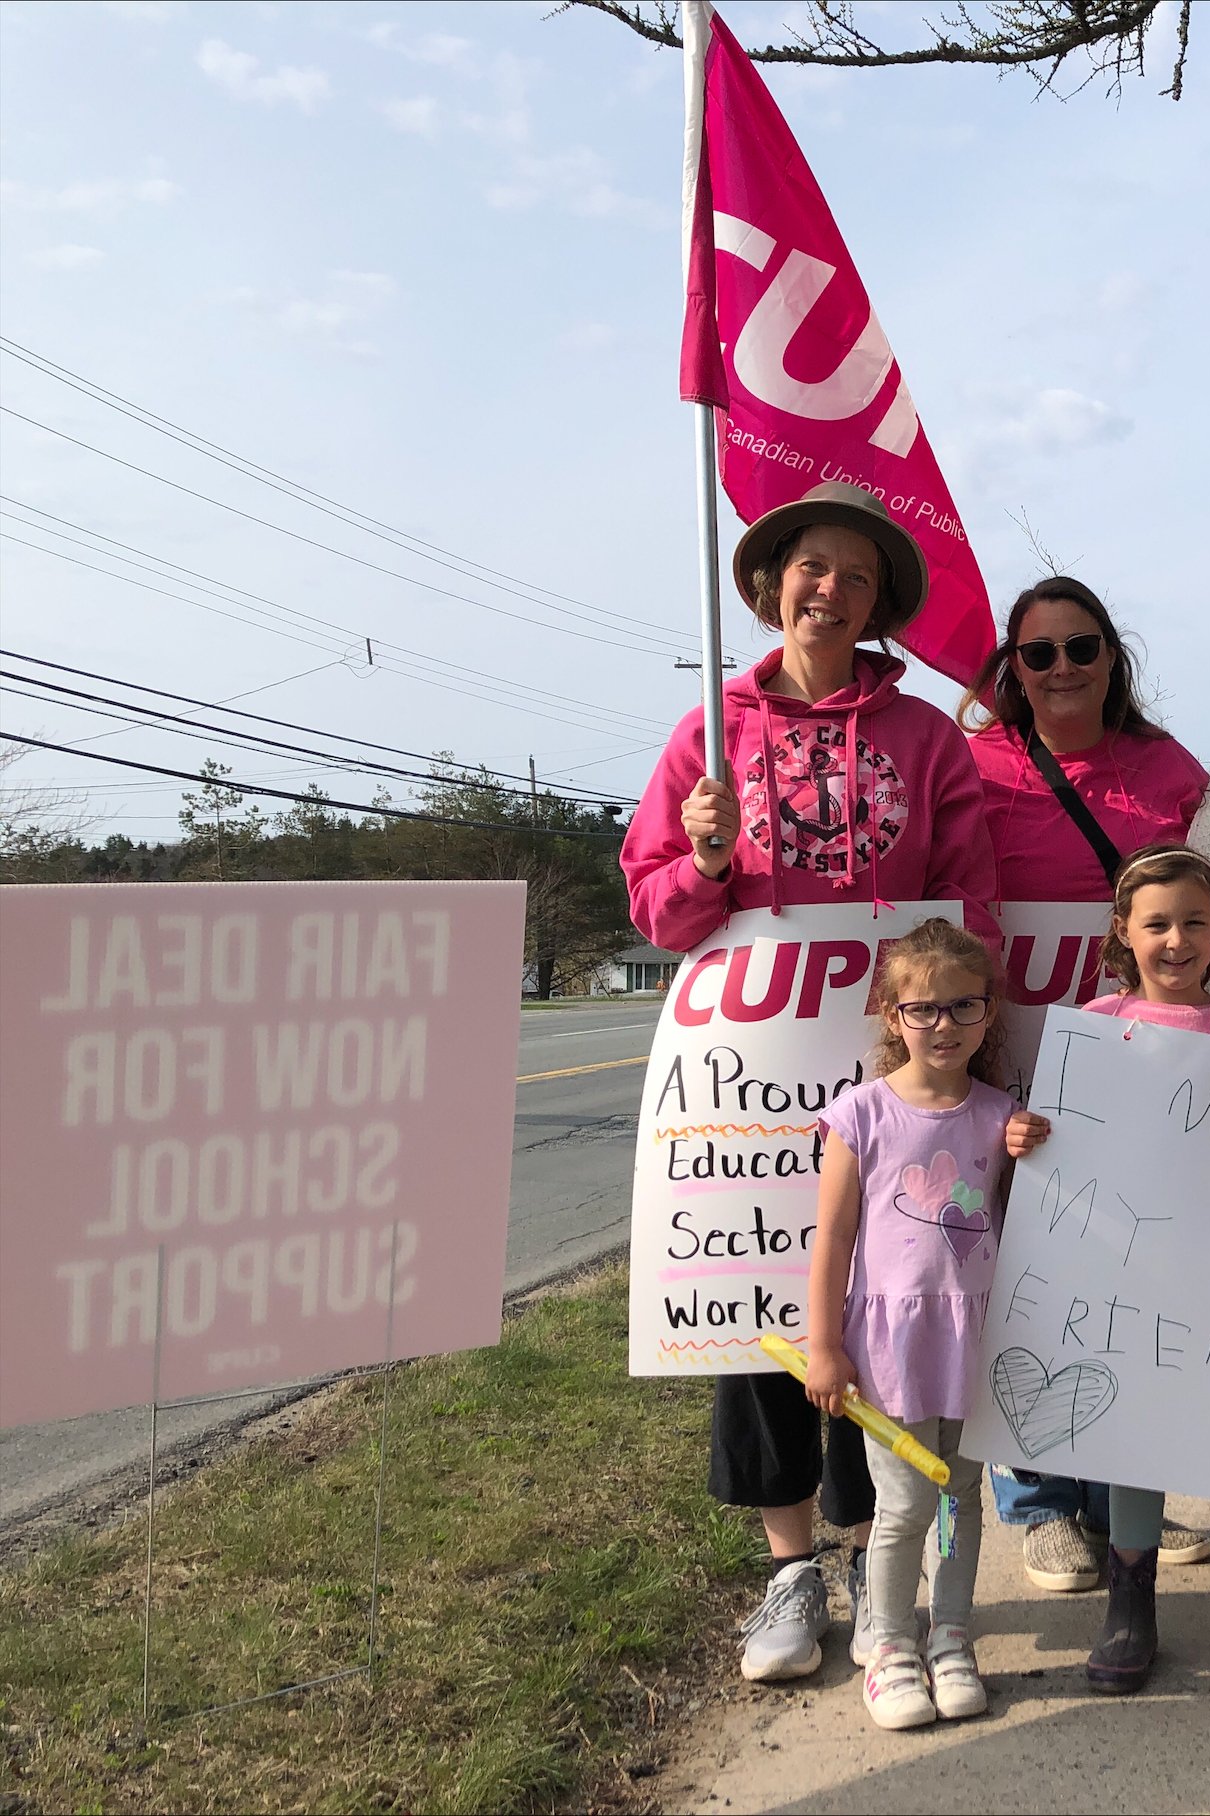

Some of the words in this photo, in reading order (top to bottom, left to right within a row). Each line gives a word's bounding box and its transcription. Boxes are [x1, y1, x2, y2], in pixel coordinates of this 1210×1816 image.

[890, 495, 915, 514] of
[915, 501, 965, 541] Public
[817, 726, 898, 782] COAST
[1001, 936, 1120, 1006] UP
[656, 1055, 687, 1116] A
[1039, 1030, 1106, 1123] I
[668, 1206, 815, 1260] Sector
[1041, 1168, 1173, 1267] MY
